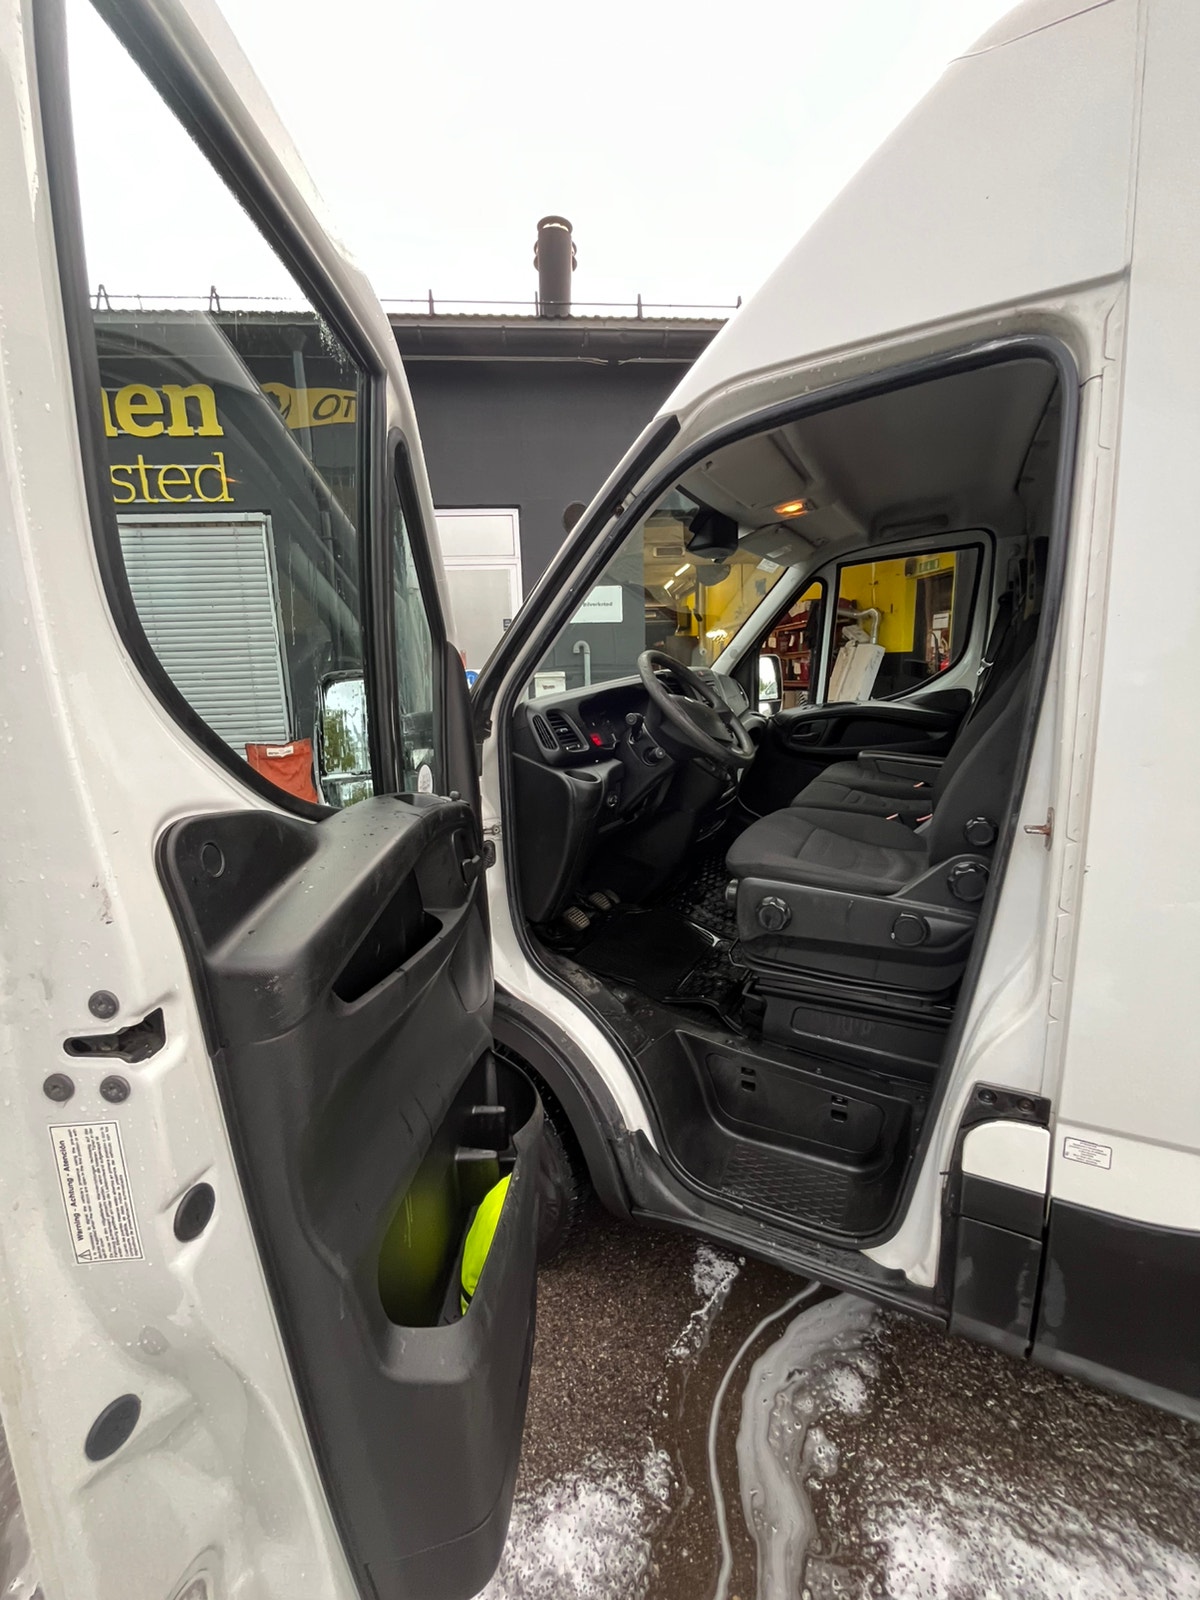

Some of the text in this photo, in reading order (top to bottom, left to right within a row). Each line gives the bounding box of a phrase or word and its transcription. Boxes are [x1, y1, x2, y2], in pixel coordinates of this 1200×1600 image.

[110, 452, 234, 503] sted
[59, 1140, 70, 1171] Atención
[67, 1178, 77, 1207] Achtung
[74, 1212, 84, 1241] Warning
